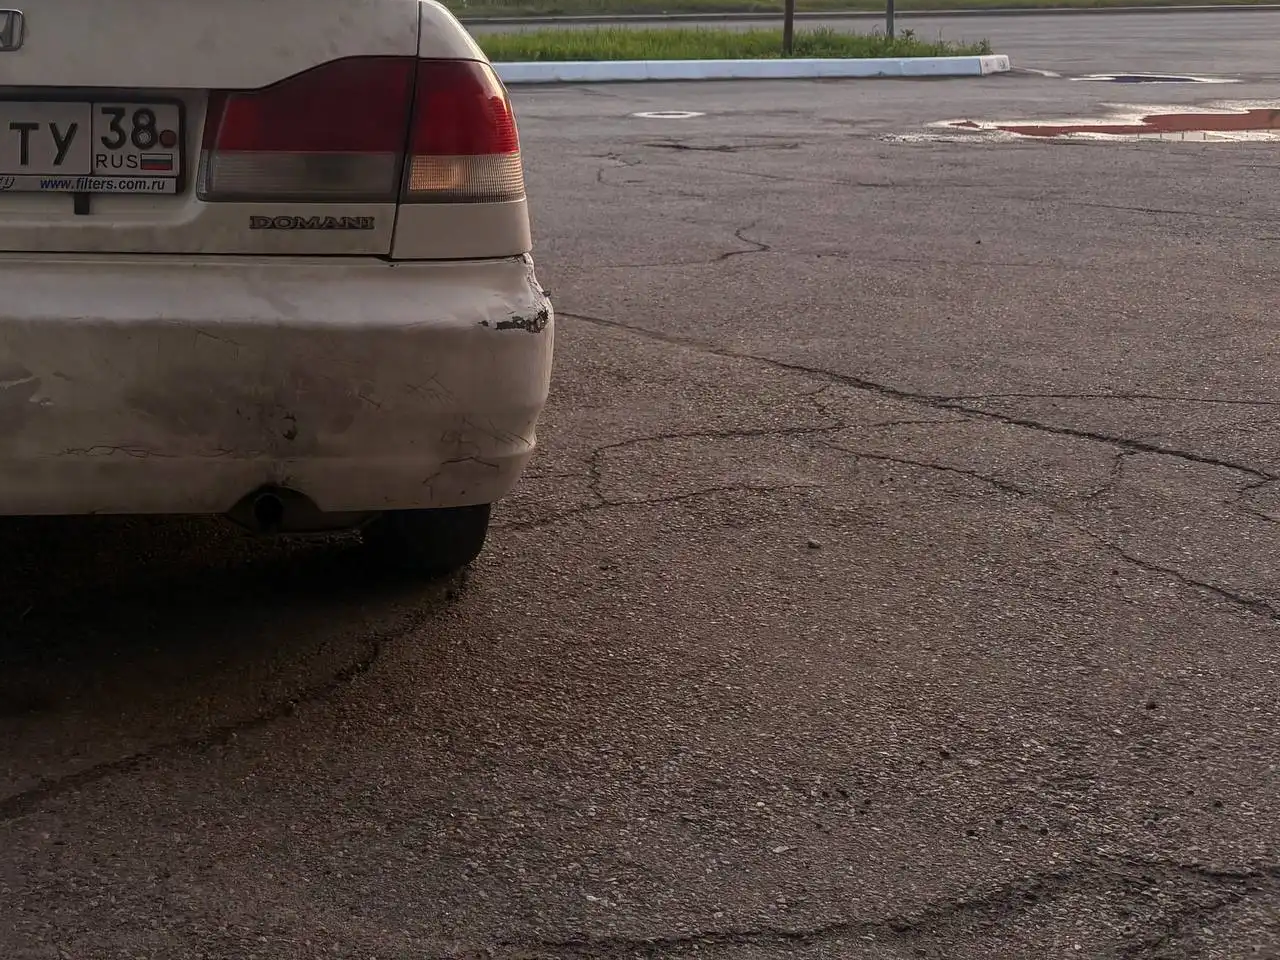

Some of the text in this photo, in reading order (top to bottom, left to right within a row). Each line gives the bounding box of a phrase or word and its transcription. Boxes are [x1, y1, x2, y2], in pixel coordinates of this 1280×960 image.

[100, 106, 159, 151] 38
[95, 154, 138, 169] RUS
[40, 177, 166, 191] www.filters.com.ru
[248, 215, 376, 231] DOMANI
